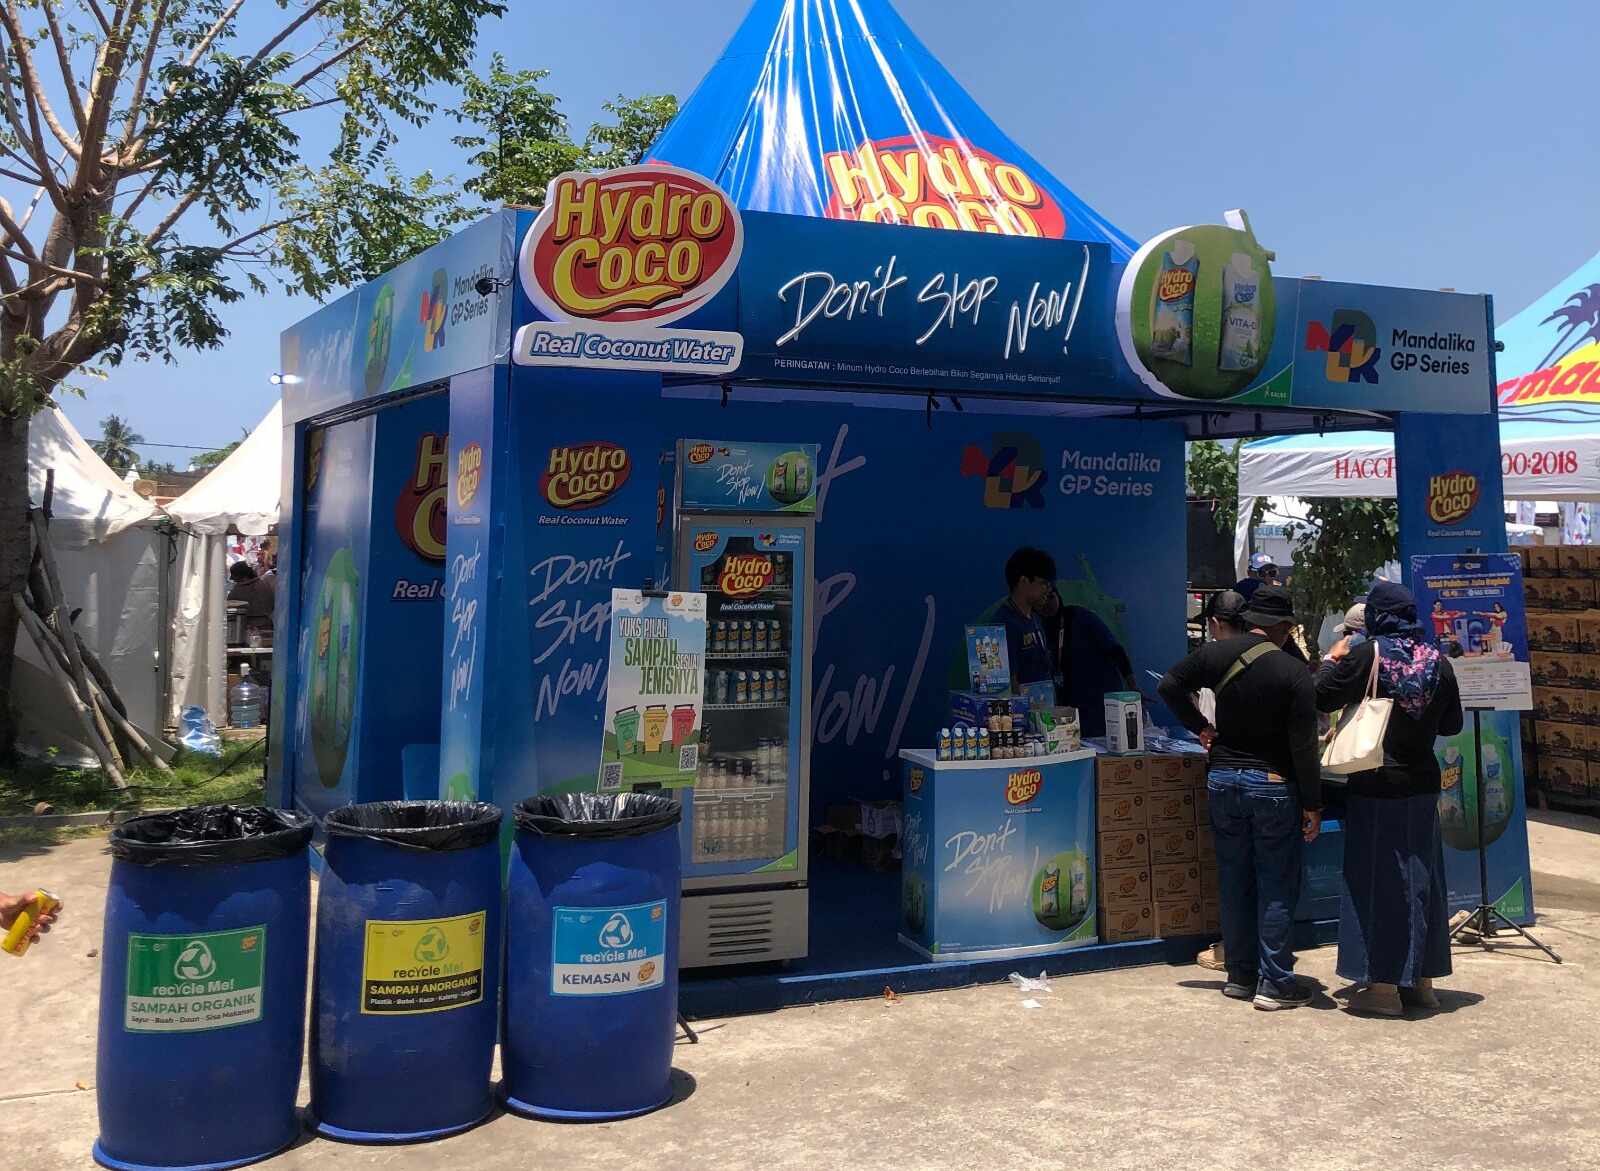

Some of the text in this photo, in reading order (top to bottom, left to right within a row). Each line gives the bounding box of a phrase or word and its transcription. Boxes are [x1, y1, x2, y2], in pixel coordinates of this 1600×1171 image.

[829, 142, 1040, 205] Hydro
[554, 178, 724, 244] Hydro
[553, 237, 700, 314] Coco
[1161, 270, 1193, 286] Hydro
[464, 296, 489, 321] Series
[775, 244, 1091, 360] Don't Stop Now!
[532, 333, 733, 363] Real Coconut Water
[1392, 329, 1475, 353] Mandalika
[774, 359, 830, 370] PERINGATAN
[837, 362, 863, 372] Minum
[864, 363, 887, 374] Hydro
[889, 365, 909, 375] Coco
[1391, 352, 1470, 375] GP Series
[549, 446, 626, 476] Hydro
[716, 457, 752, 483] Don't
[1061, 449, 1161, 473] Mandalika
[1059, 474, 1154, 497] GP Series
[1430, 474, 1477, 498] Hydro
[538, 515, 629, 526] Real Coconut Water
[529, 540, 632, 605] Don't
[723, 556, 772, 577] Hydro
[392, 578, 439, 599] Real
[618, 616, 668, 638] YUKS PILAH
[624, 638, 678, 667] SAMPAH
[638, 666, 698, 696] JENISNYA
[1007, 771, 1041, 788] Hydro
[944, 818, 1017, 872] Don't
[627, 946, 647, 958] Me!
[207, 978, 234, 993] Me!
[370, 975, 479, 996] SAMPAH ANORGANIK
[562, 971, 630, 984] KEMASAN
[131, 993, 257, 1014] SAMPAH ORGANIK
